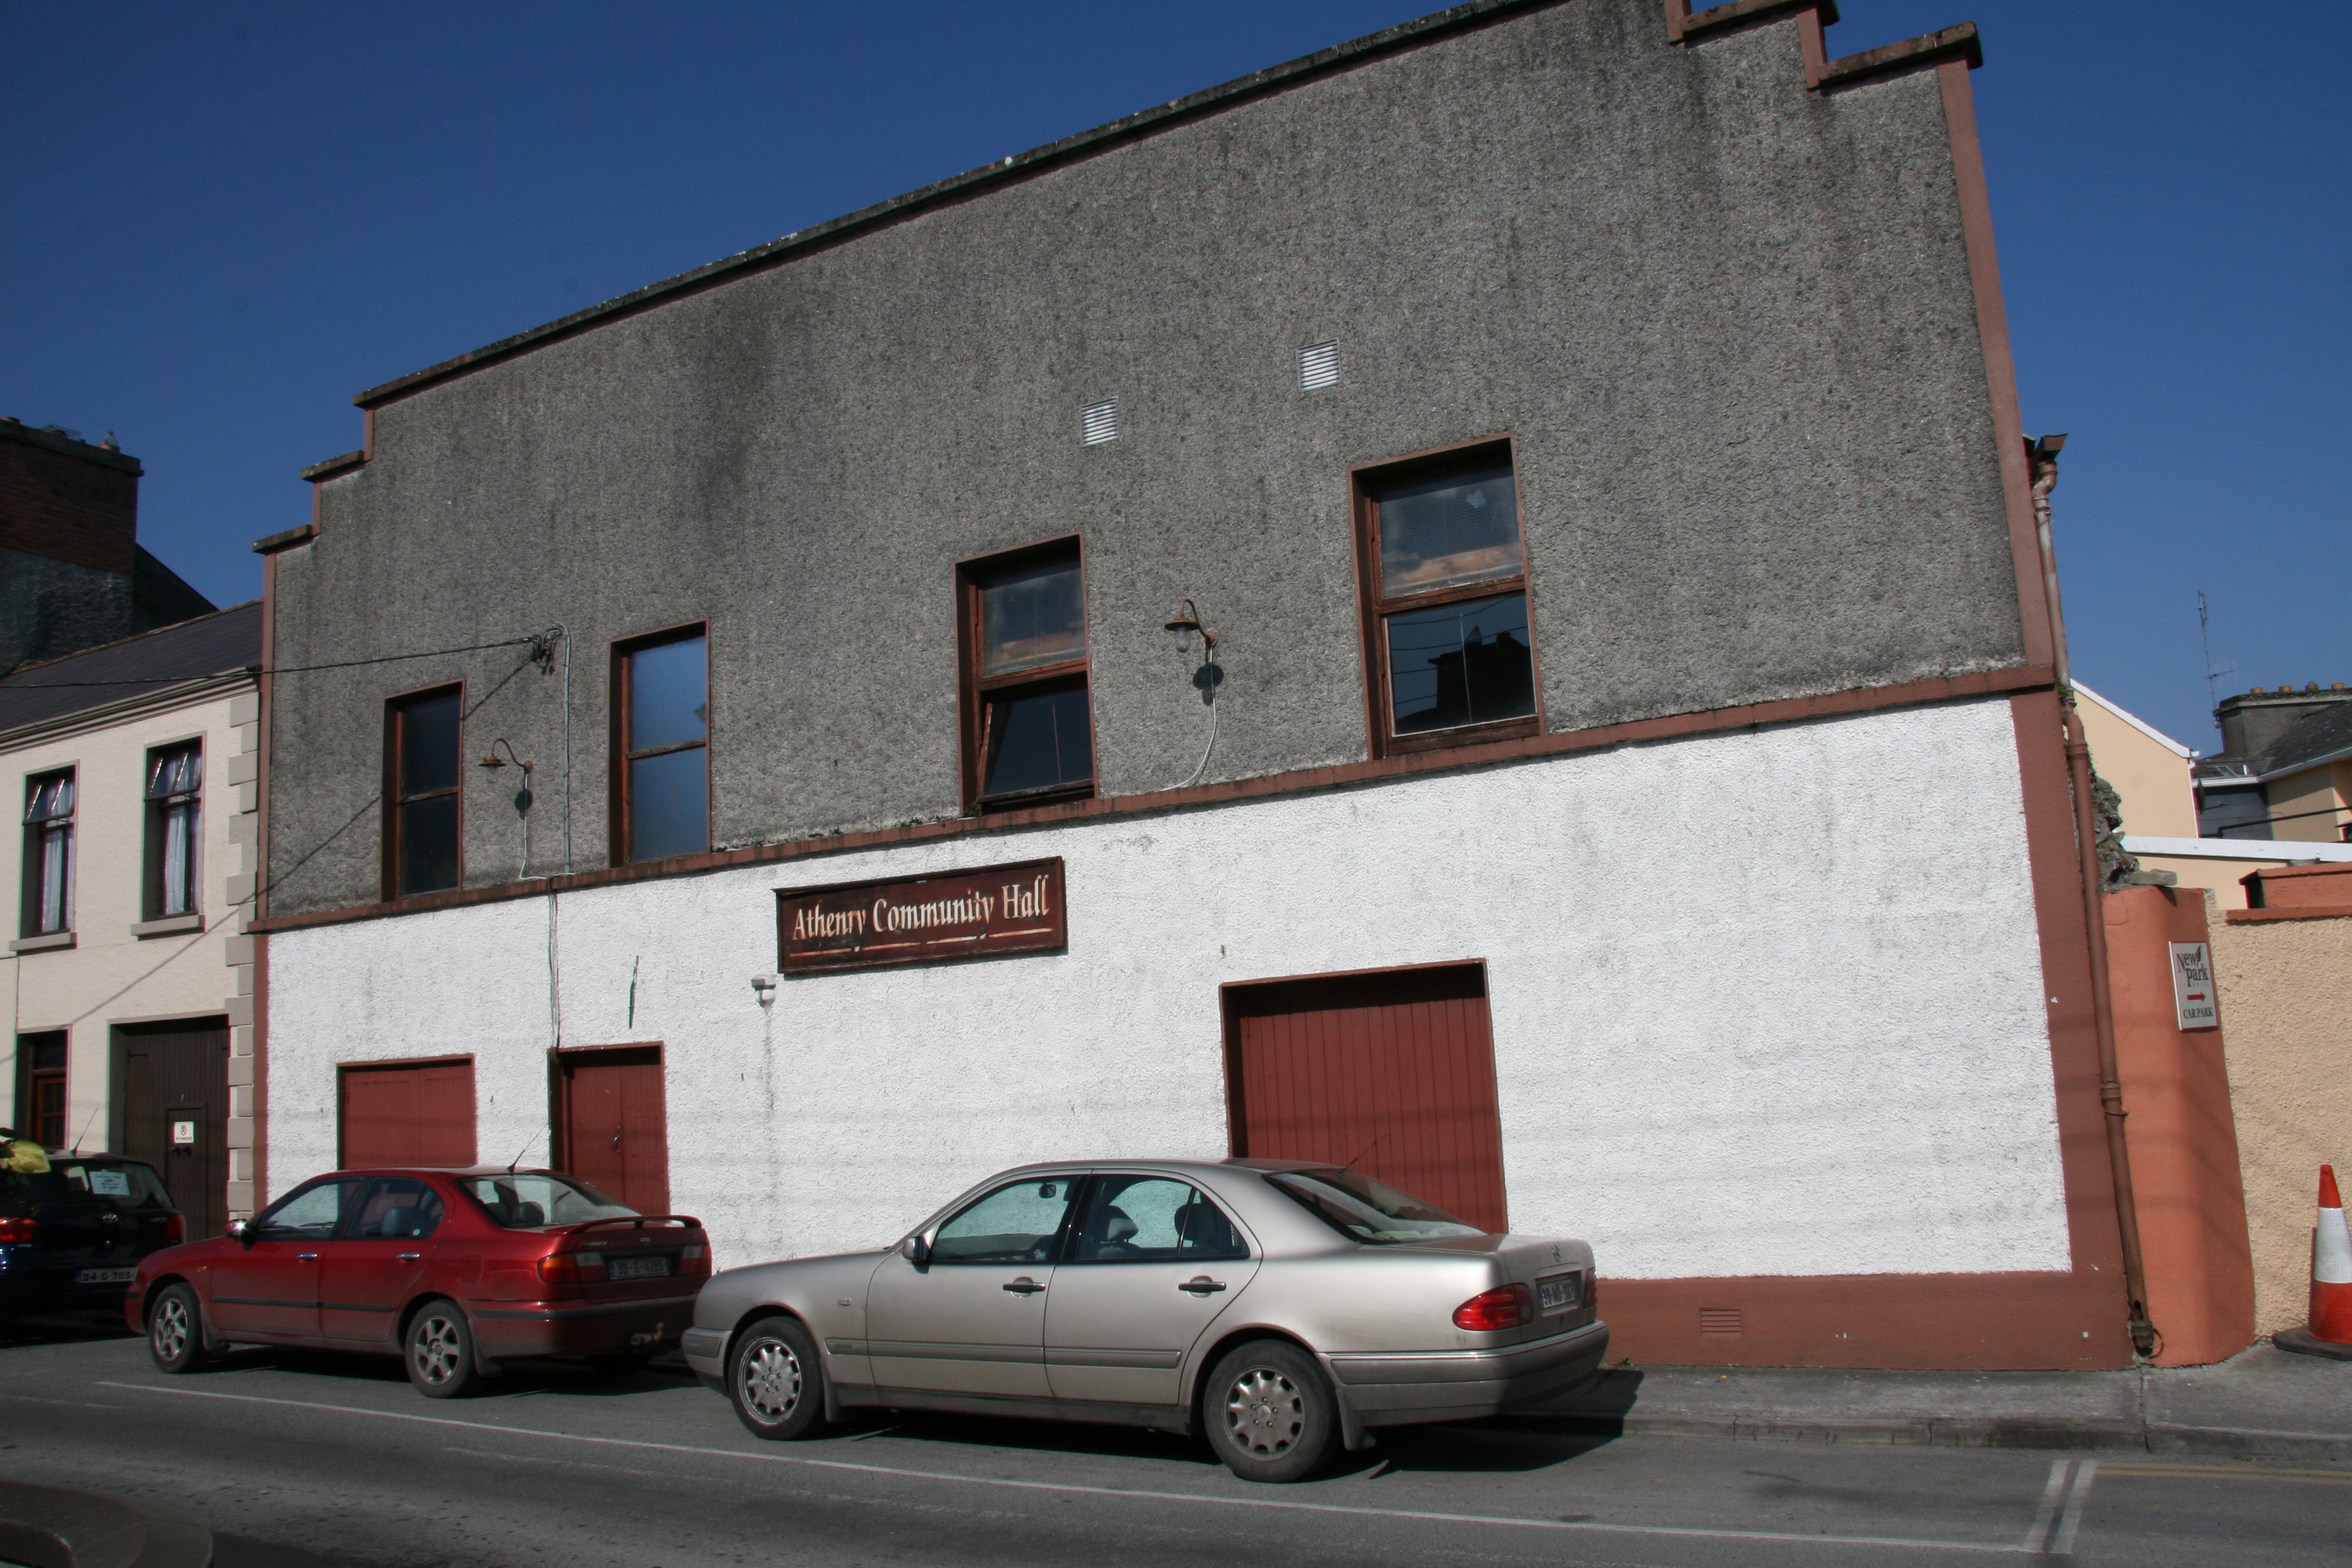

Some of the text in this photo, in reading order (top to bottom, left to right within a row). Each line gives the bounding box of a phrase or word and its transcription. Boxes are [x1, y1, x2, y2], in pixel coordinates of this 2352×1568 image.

[792, 875, 1049, 940] Athenry Community Hall
[2177, 952, 2199, 973] New
[2183, 1007, 2214, 1019] CAR PARK
